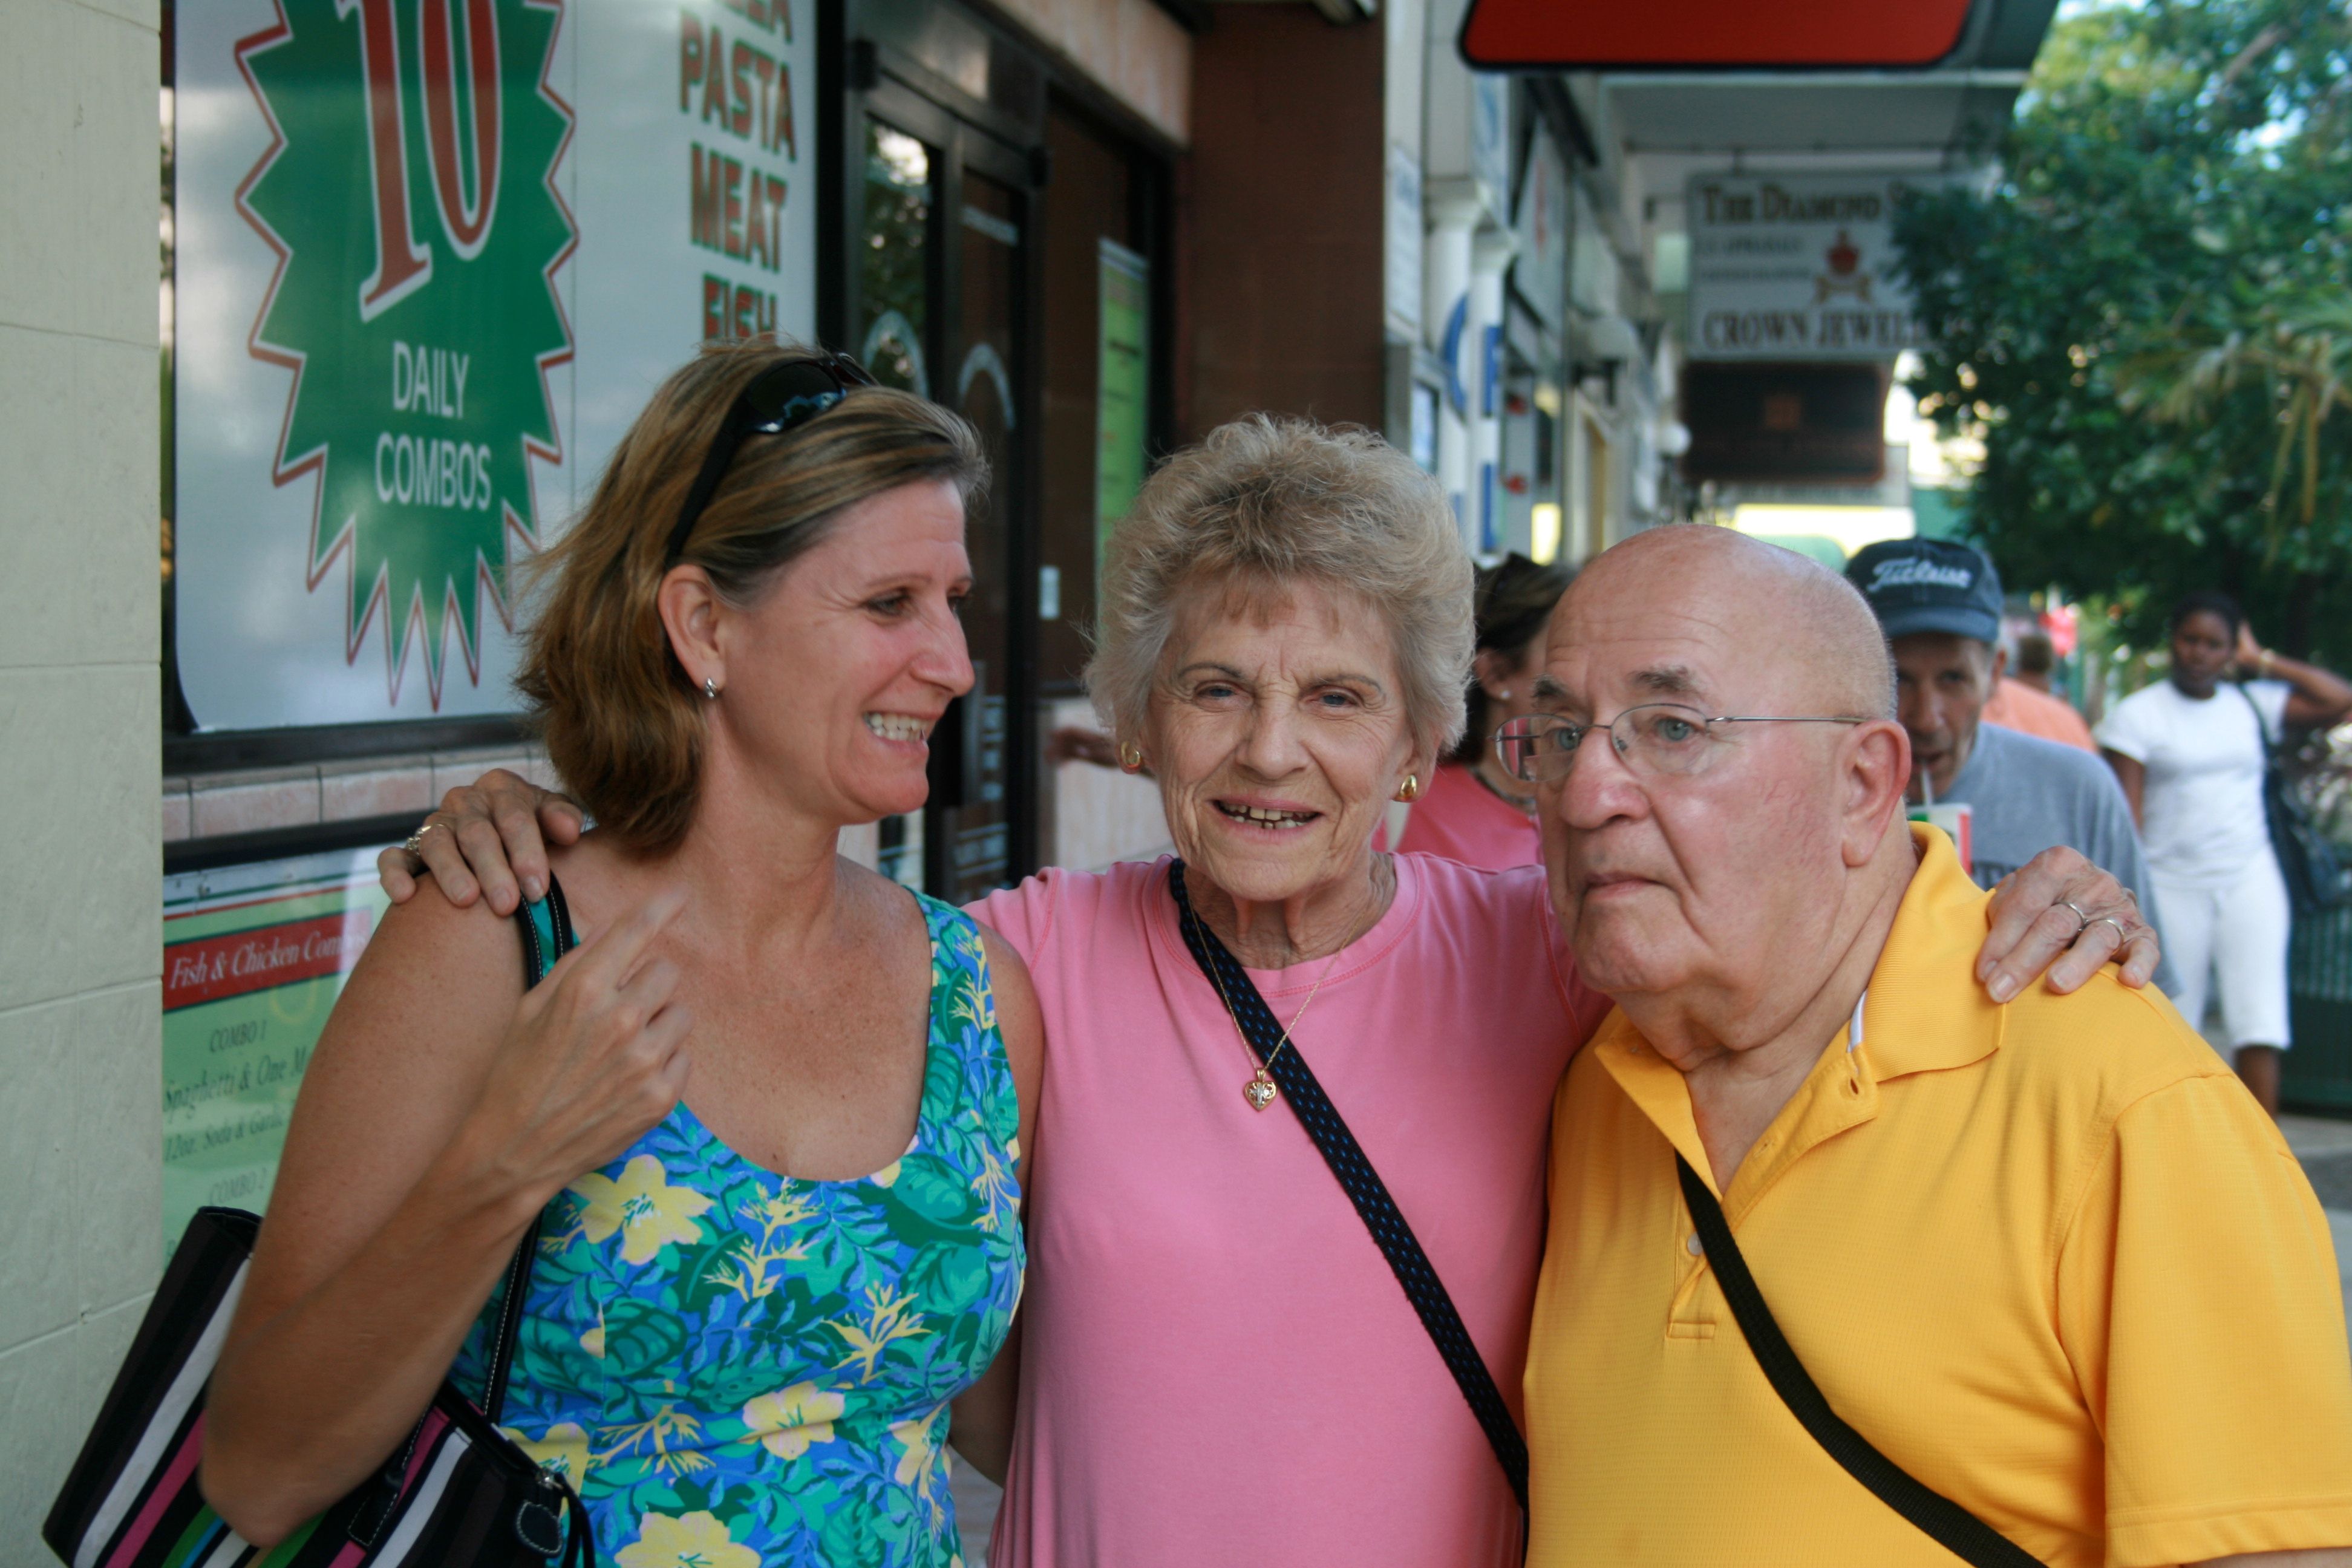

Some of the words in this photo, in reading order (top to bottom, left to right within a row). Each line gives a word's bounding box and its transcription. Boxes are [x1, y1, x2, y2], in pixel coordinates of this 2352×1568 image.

[679, 7, 797, 163] PASTA
[690, 141, 787, 273] MEAT
[1704, 310, 1808, 350] CROWN
[1818, 309, 1926, 347] JEWEL
[393, 339, 469, 419] DAILY
[375, 431, 492, 512] COMBOS
[170, 950, 207, 990] Fish
[211, 950, 226, 981] &
[231, 936, 300, 977] Chicken
[209, 1020, 258, 1053] COMBO
[209, 1171, 258, 1206] COMBO
